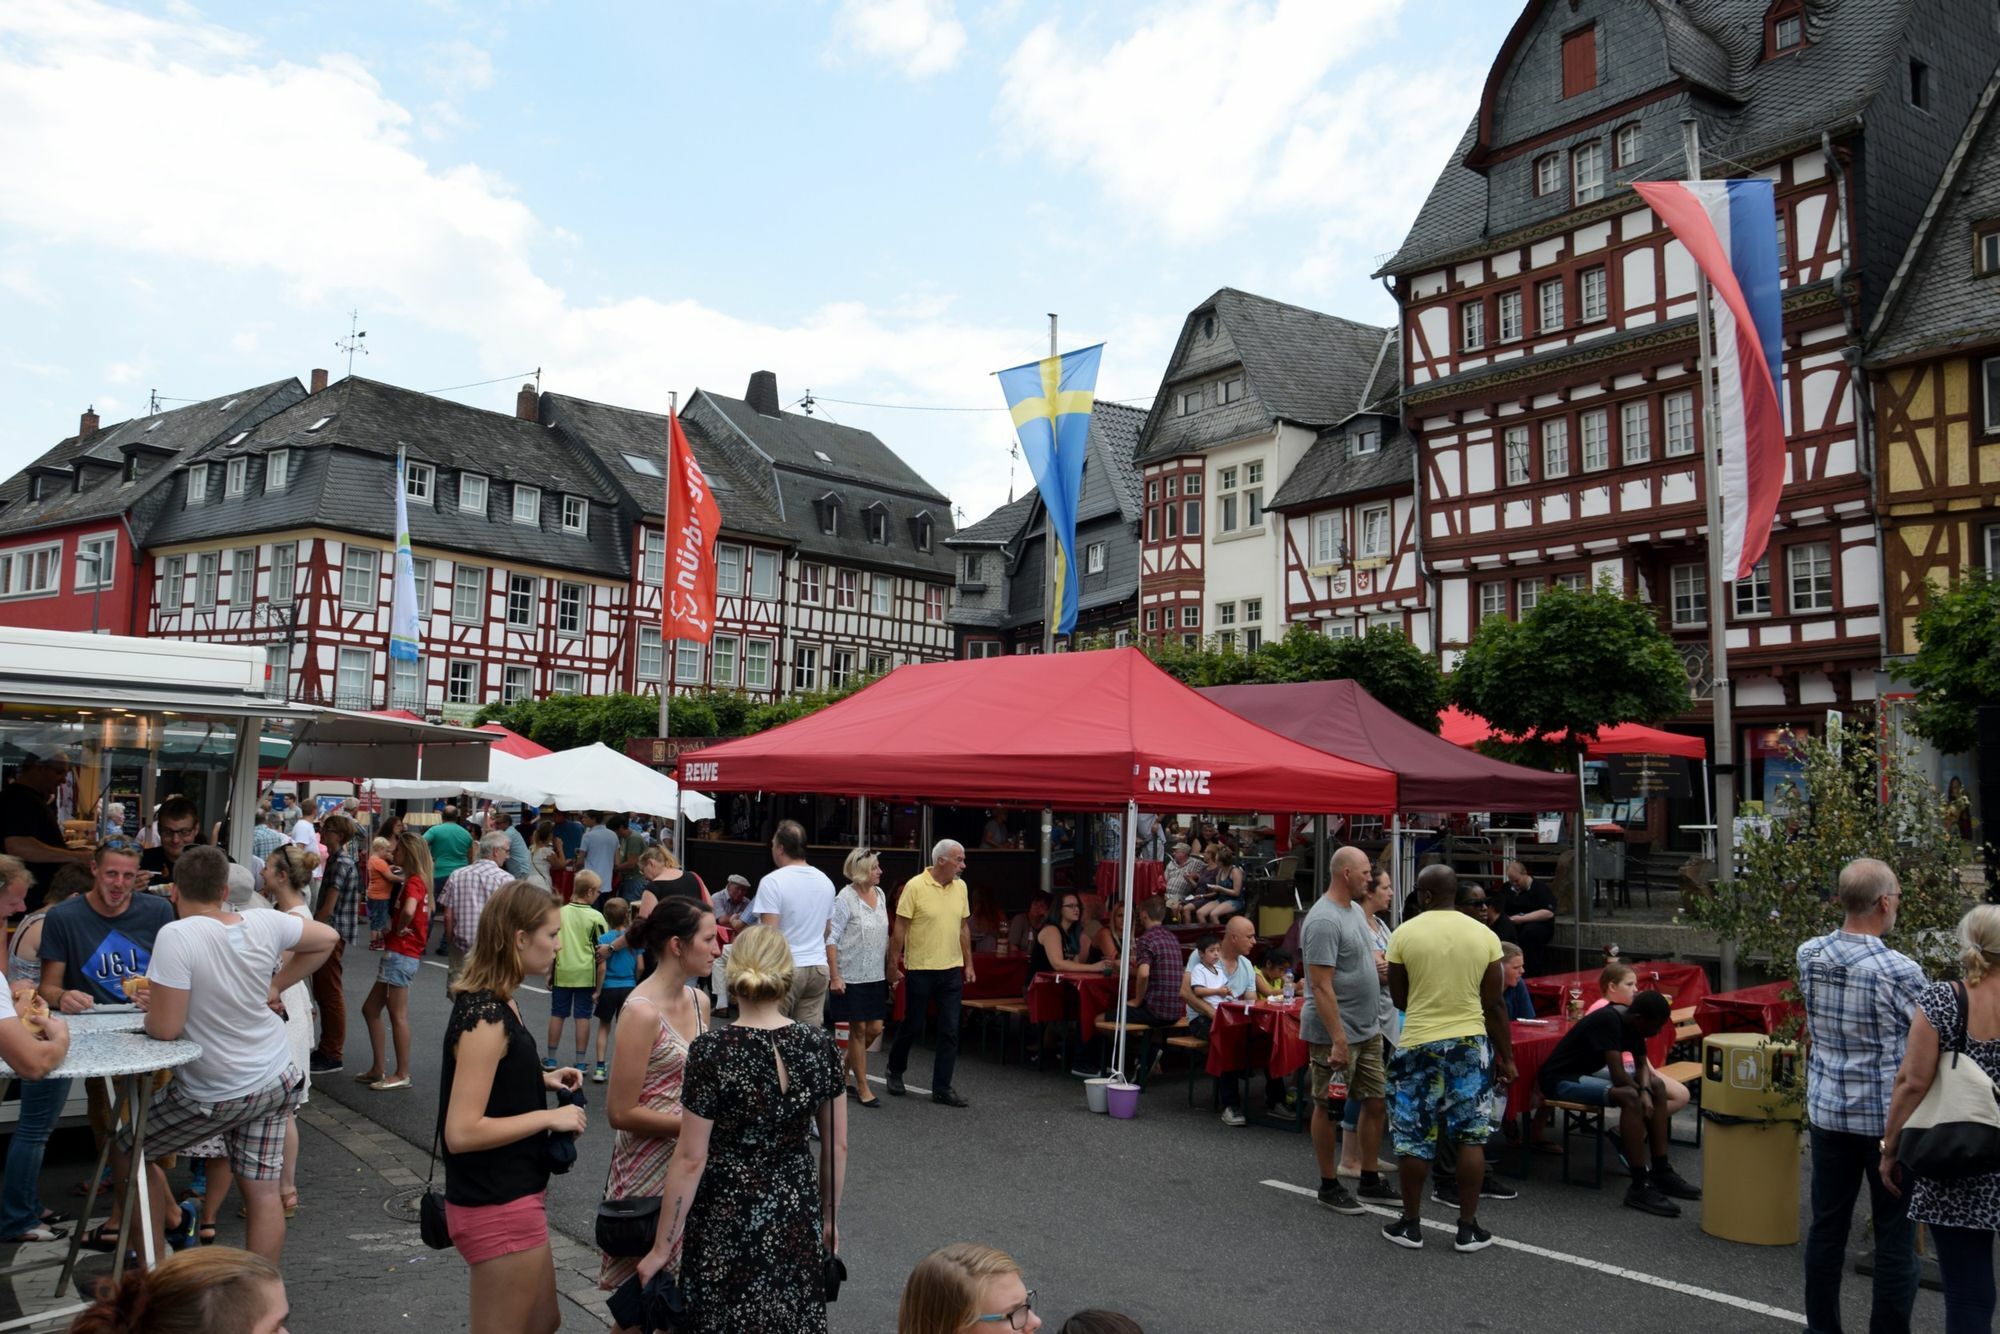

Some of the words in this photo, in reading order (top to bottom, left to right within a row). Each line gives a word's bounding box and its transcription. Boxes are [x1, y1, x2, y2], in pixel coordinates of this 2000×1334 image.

[685, 762, 719, 782] REWE
[1148, 766, 1211, 795] REWE
[96, 948, 137, 979] J&J
